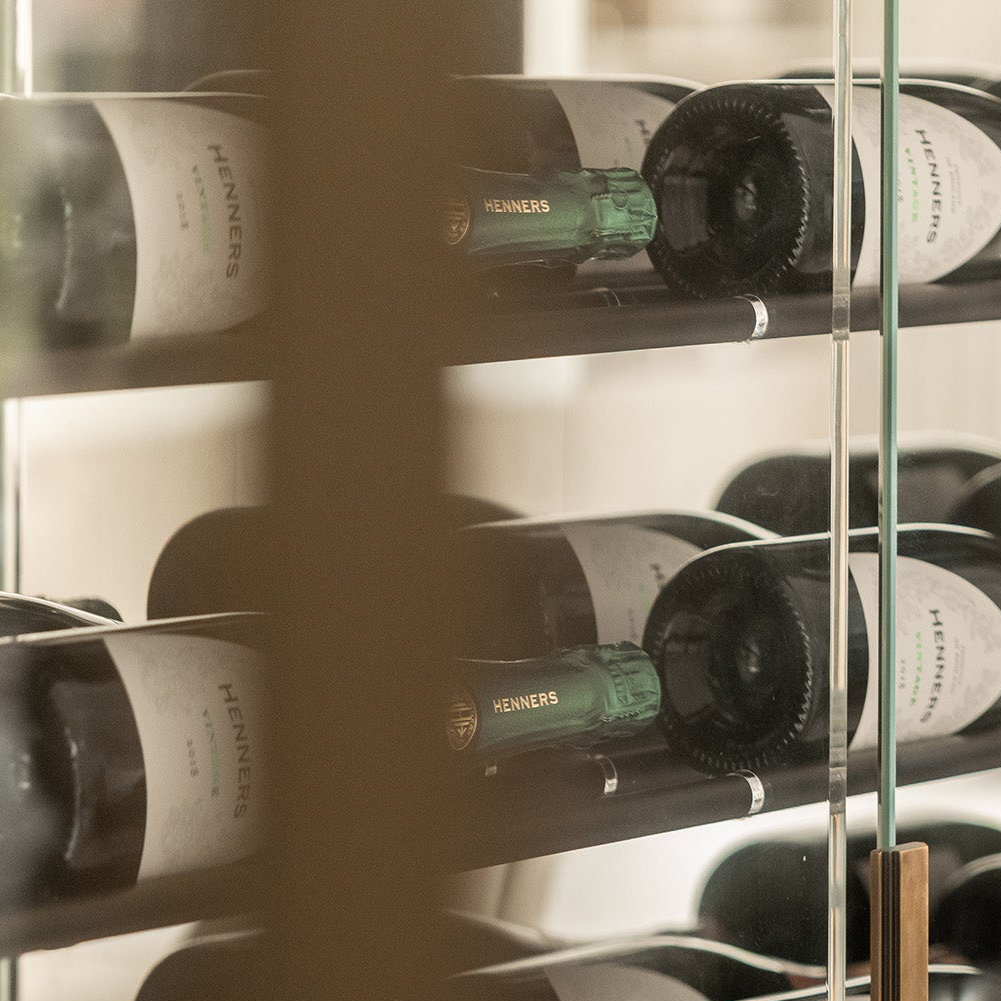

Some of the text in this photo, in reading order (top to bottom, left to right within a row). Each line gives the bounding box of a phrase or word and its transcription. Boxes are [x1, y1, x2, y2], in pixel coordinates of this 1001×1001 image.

[208, 144, 243, 279] HENNERS
[484, 199, 550, 213] HENNERS
[914, 129, 943, 244] HENNERS
[492, 691, 559, 713] HENNERS
[920, 609, 946, 723] HENNERS
[218, 683, 252, 819] HENNERS
